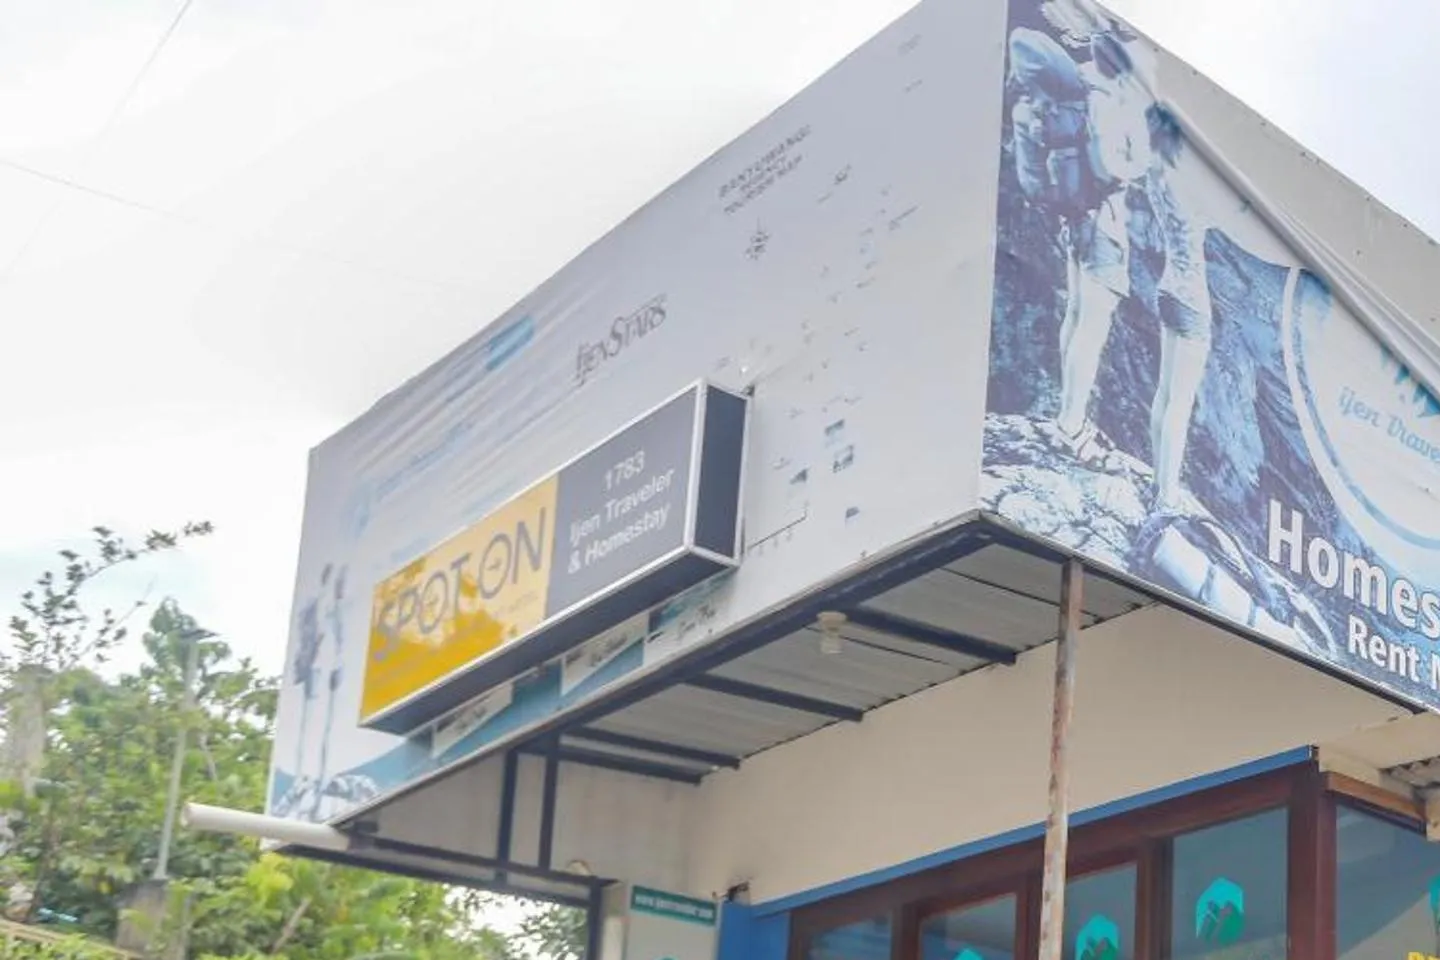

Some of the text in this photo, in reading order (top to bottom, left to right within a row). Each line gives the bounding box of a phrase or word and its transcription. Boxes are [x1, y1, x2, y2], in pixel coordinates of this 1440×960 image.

[603, 450, 646, 491] 1783
[604, 467, 675, 523] Traveler
[567, 502, 672, 575] & Homestay
[373, 504, 547, 663] SPOT ON
[1348, 616, 1422, 684] Rent
